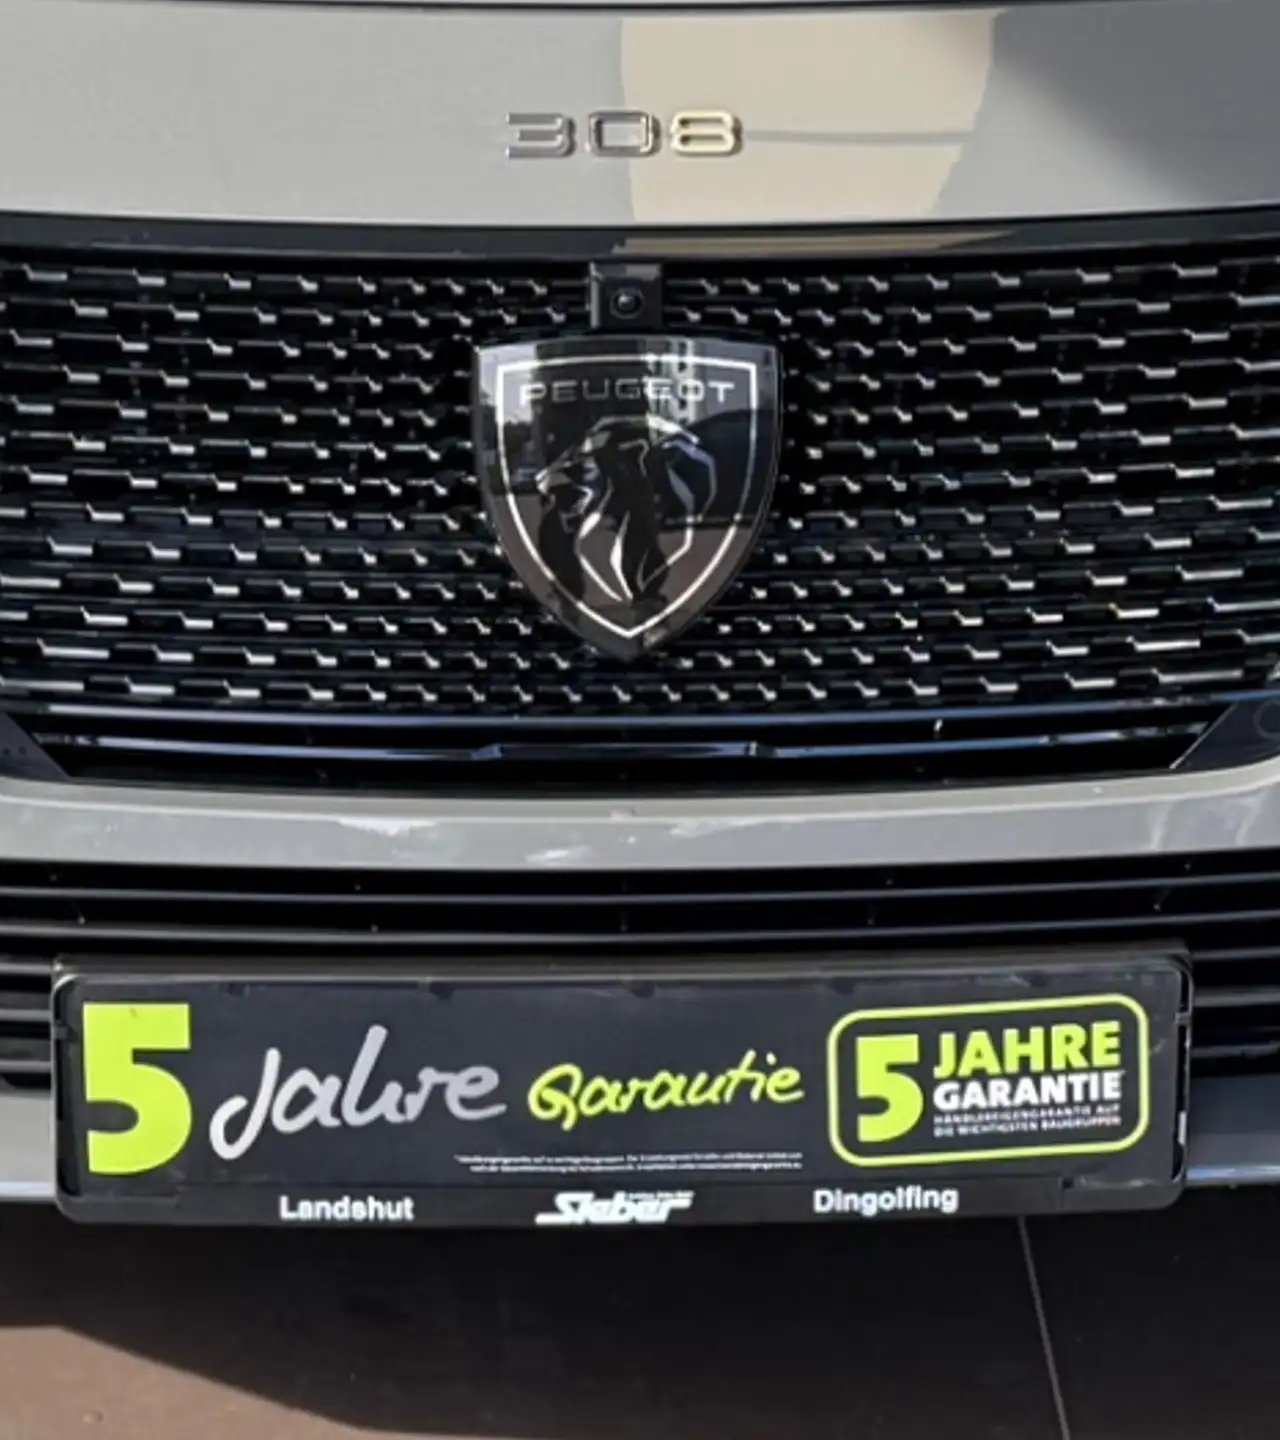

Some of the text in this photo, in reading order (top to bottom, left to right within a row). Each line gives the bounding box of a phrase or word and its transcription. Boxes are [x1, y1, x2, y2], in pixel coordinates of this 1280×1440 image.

[506, 111, 741, 157] 308
[519, 378, 736, 402] PEUGEOT
[83, 1003, 805, 1175] 5 Jahre Garantie
[856, 1020, 1121, 1143] 5 JAHRE
[279, 1185, 959, 1225] Landshut Sieber Dingolfing
